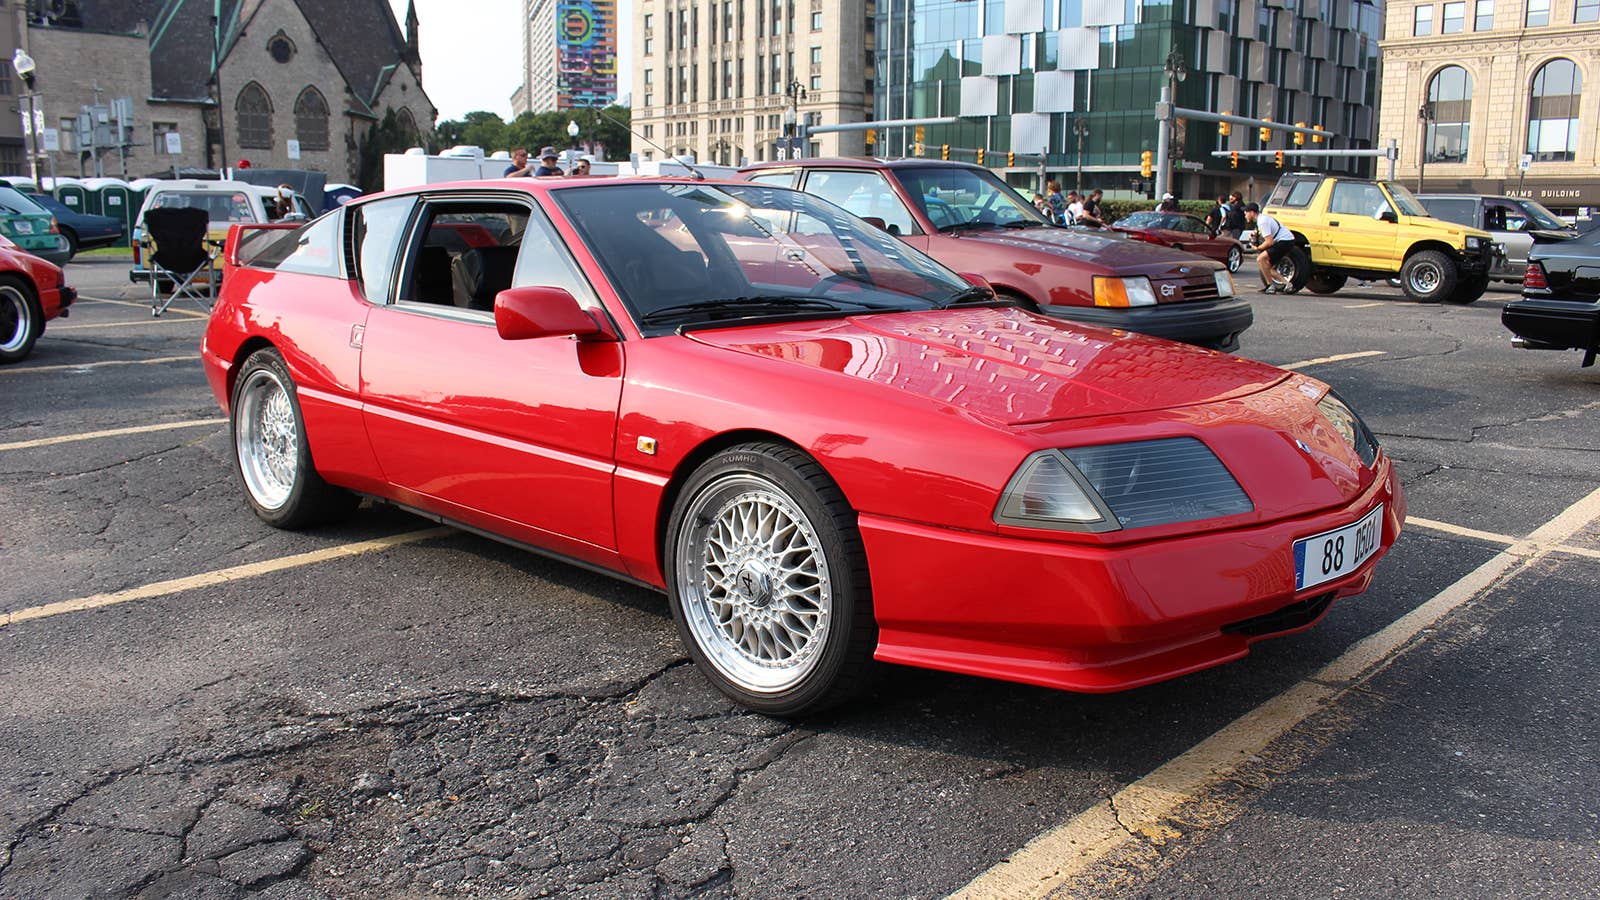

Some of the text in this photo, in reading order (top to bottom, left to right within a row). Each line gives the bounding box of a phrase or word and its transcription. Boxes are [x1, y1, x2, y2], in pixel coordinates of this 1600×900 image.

[1541, 190, 1580, 198] BUILDING
[1160, 284, 1176, 296] GT
[722, 454, 757, 464] KUMHO
[1322, 535, 1345, 575] 88
